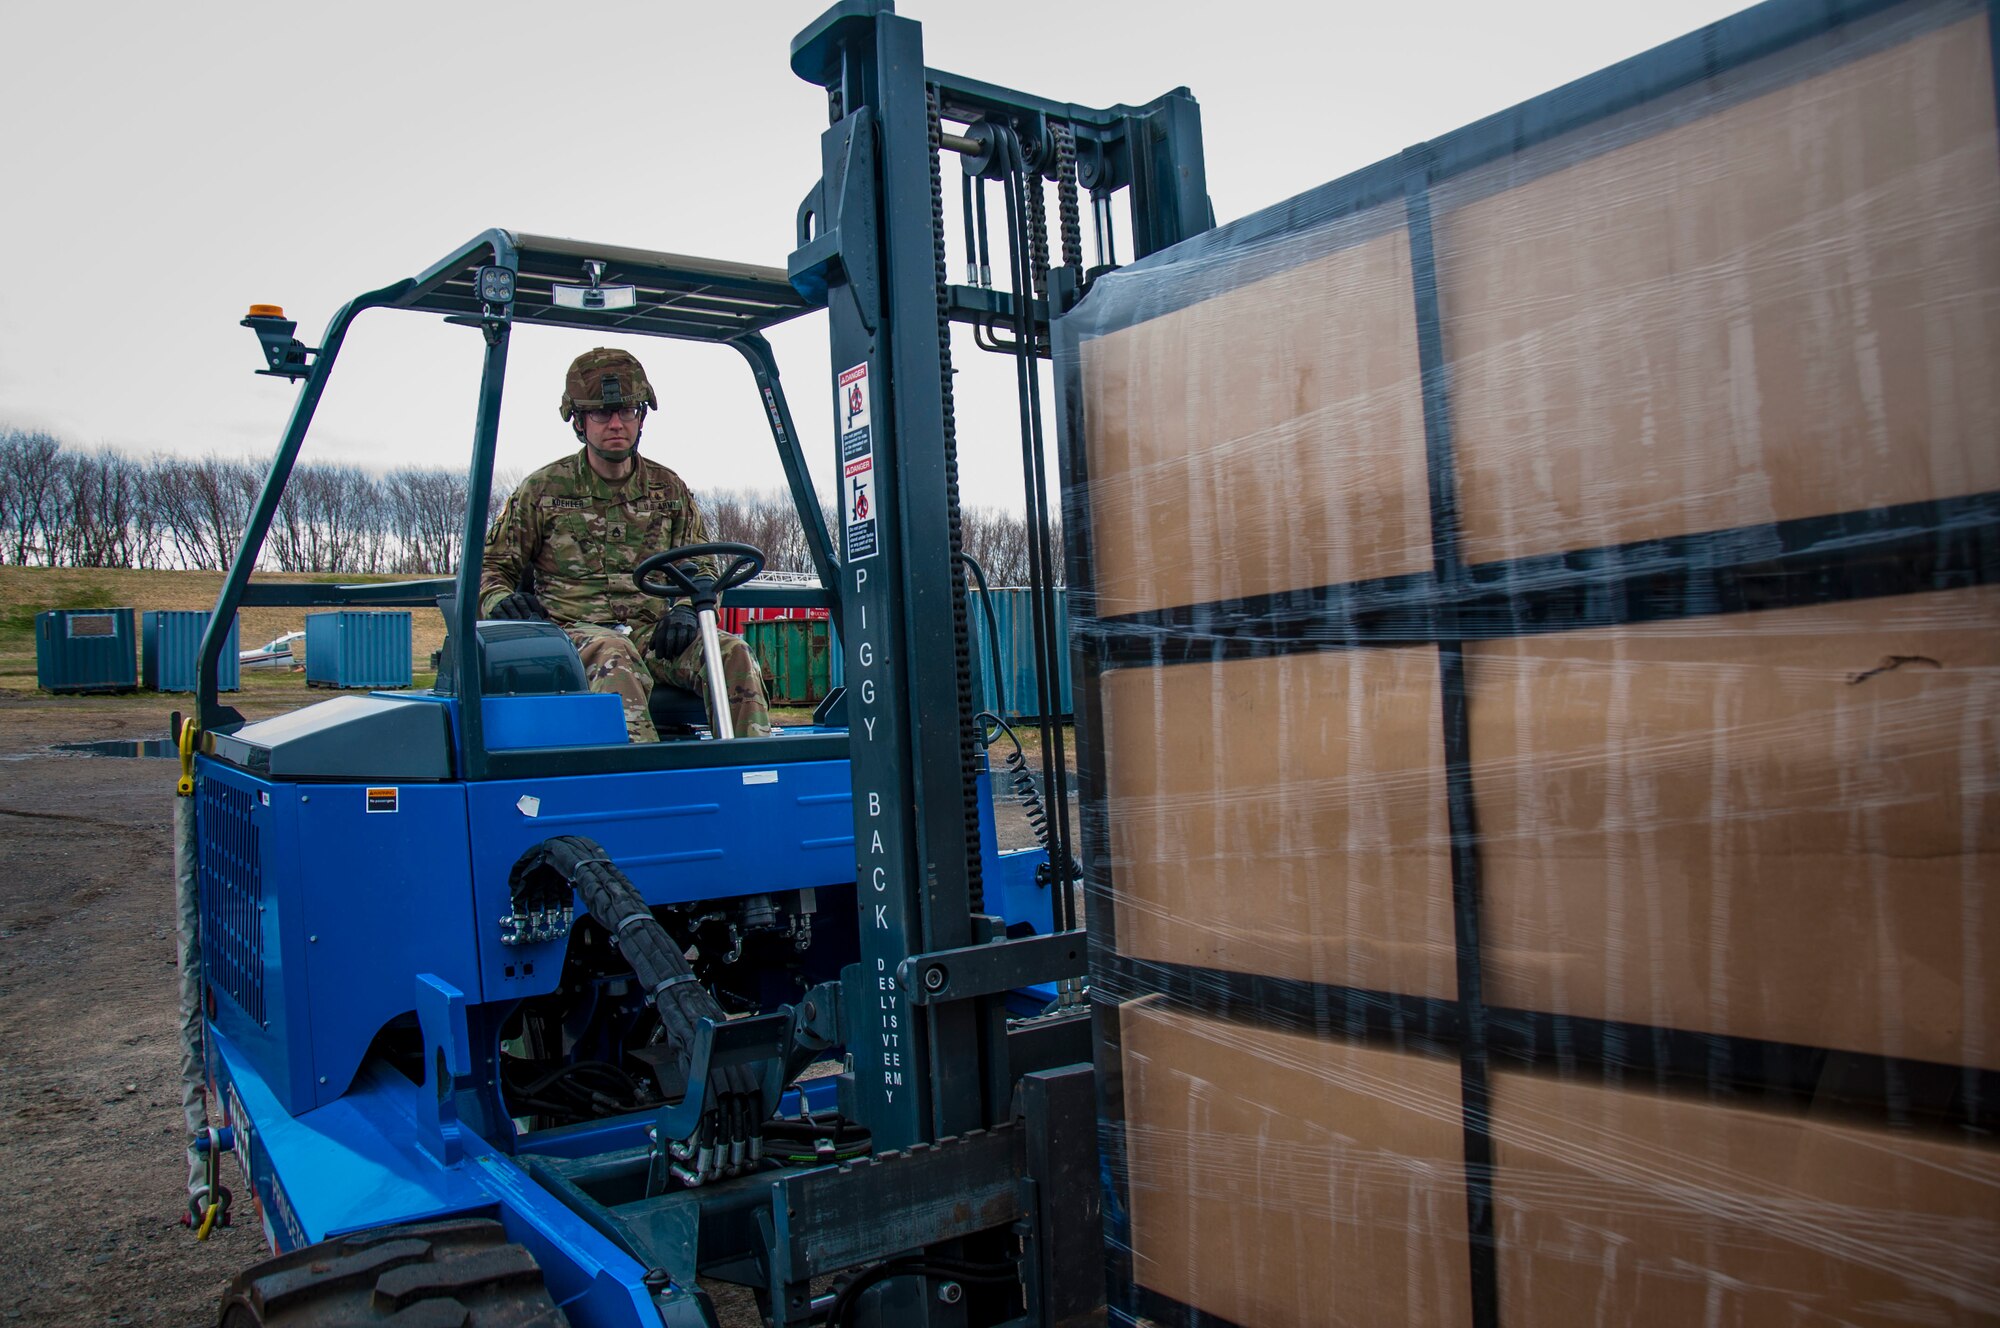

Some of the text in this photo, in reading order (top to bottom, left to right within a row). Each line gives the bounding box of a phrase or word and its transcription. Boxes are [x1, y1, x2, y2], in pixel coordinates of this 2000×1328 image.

[845, 368, 865, 381] DANGER
[849, 461, 870, 473] DANGER
[856, 569, 888, 929] PIGGY BACK
[878, 958, 893, 1103] DELIVERY
[888, 977, 902, 1086] SYSTEM
[272, 1172, 307, 1248] PRINCETO
